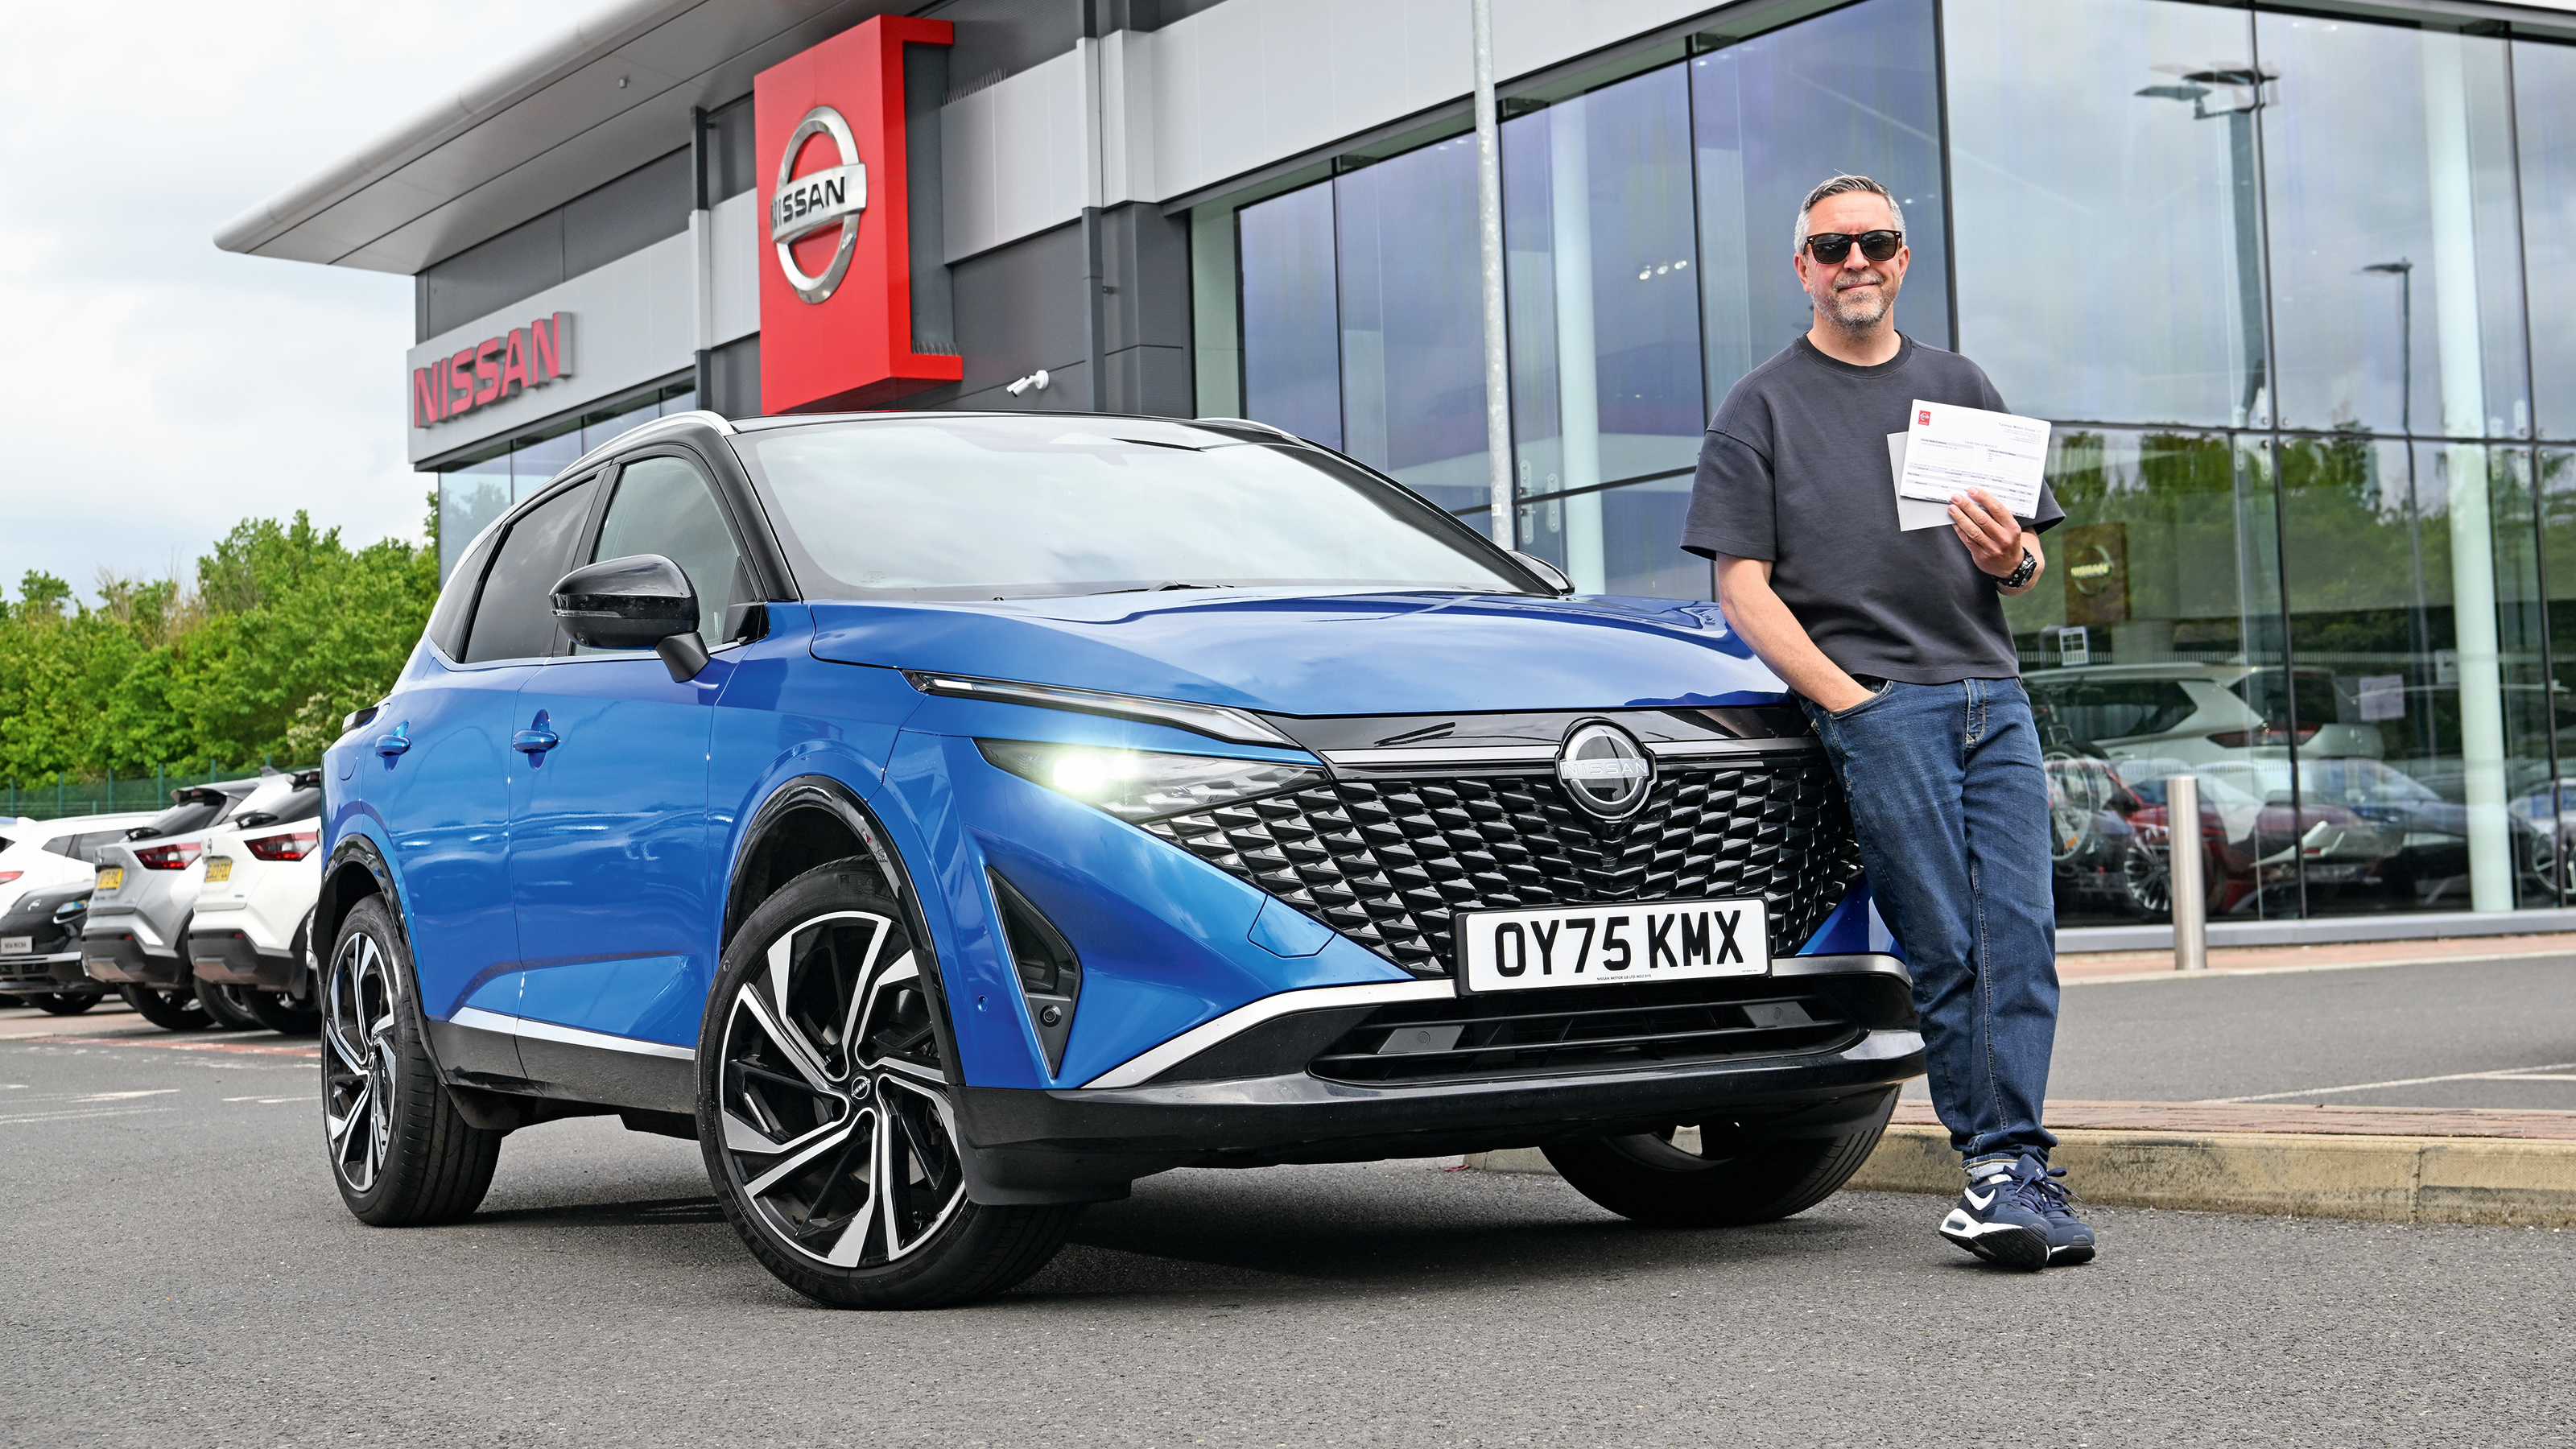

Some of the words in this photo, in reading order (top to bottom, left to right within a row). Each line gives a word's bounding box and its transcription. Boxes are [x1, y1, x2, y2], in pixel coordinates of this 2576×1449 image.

[770, 175, 845, 229] NISSAN
[414, 312, 560, 428] NISSAN
[1563, 762, 1647, 776] NISSAN
[1495, 916, 1632, 977] OY75
[1647, 910, 1744, 968] KMX
